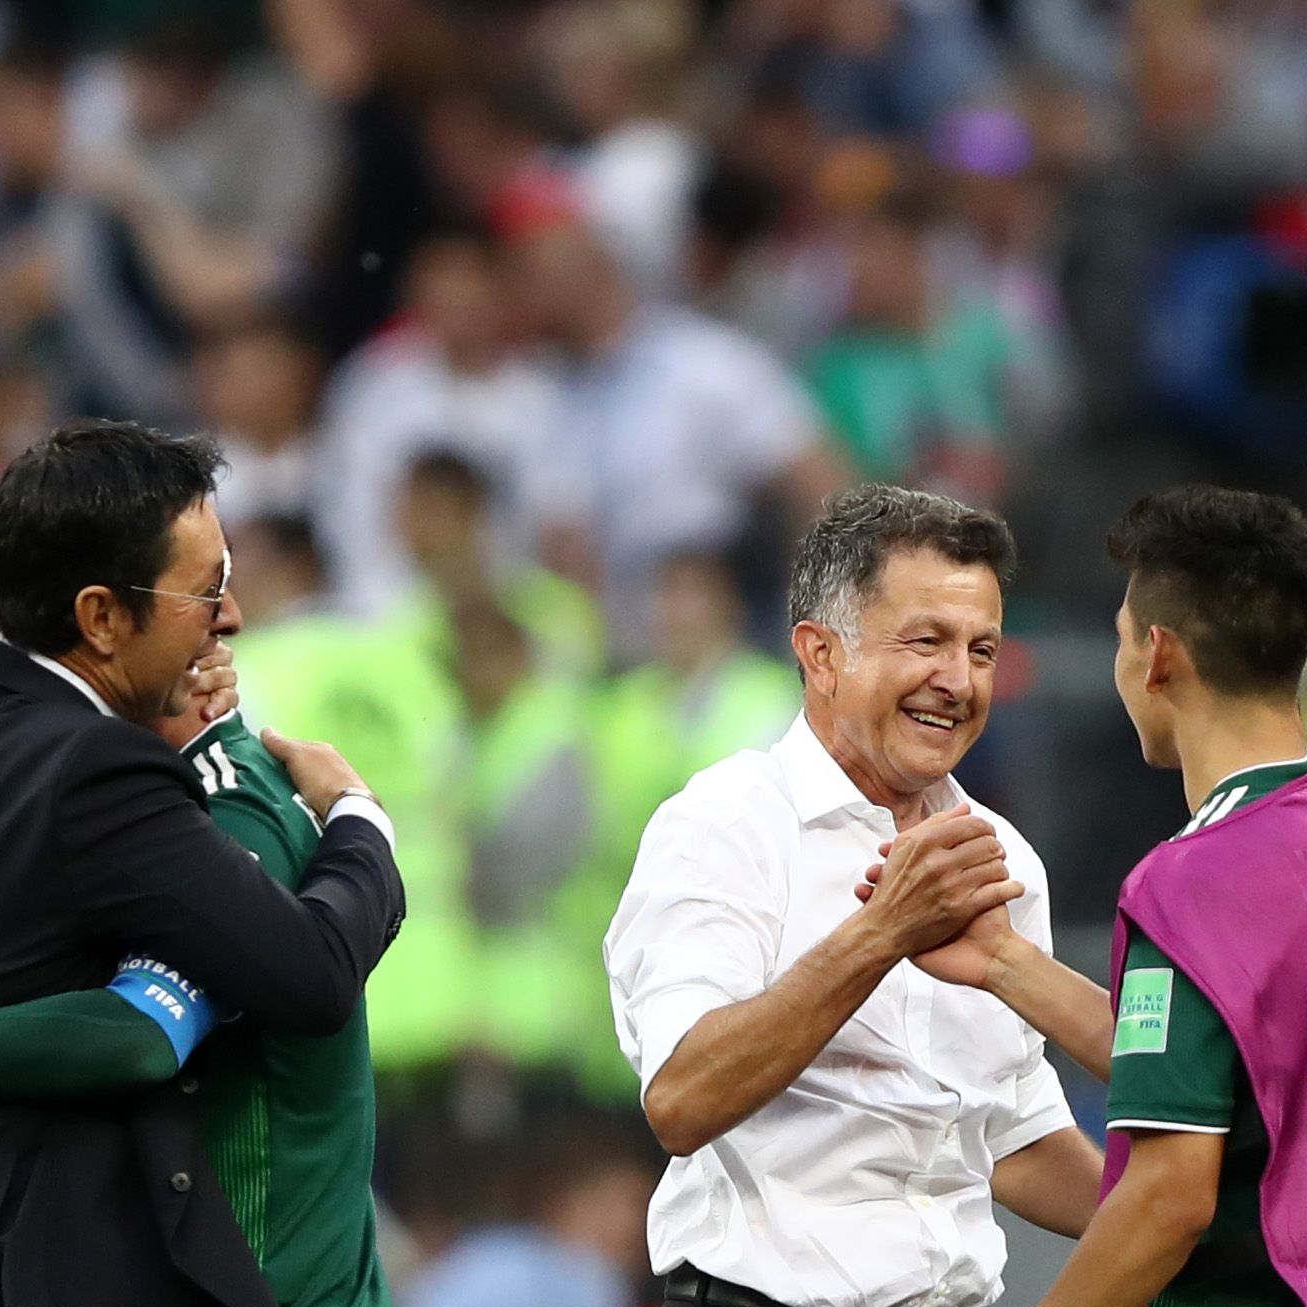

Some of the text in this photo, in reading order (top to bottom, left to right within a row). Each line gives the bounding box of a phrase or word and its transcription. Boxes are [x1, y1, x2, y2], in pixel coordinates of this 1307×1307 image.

[123, 958, 198, 1002] OTBALL
[144, 984, 185, 1020] FIFA
[1139, 1020, 1161, 1029] FIFA
